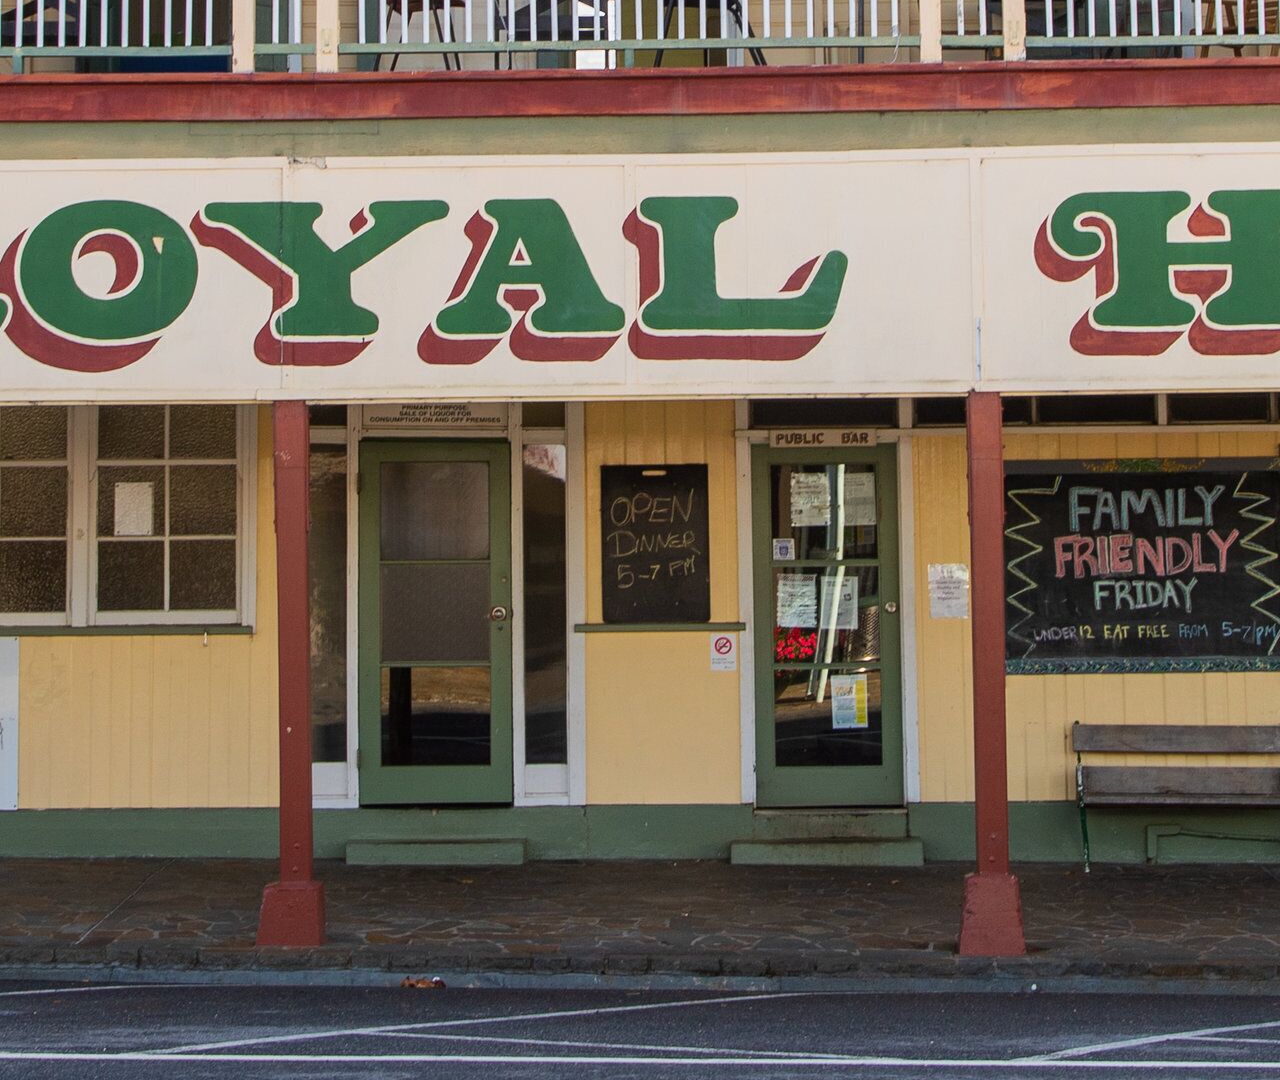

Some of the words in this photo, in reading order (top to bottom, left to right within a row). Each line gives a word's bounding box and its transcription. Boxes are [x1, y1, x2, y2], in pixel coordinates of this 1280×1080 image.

[775, 431, 824, 446] PUBLIC
[841, 431, 869, 445] BAR
[609, 488, 695, 527] OPEN
[1068, 484, 1225, 532] FAMILY
[1053, 528, 1240, 579] FRIENDLY
[617, 564, 661, 589] 5-7
[1093, 577, 1198, 613] FRIDAY
[1033, 626, 1078, 641] UNDER
[1079, 625, 1095, 639] 12
[1103, 624, 1130, 639] EAT
[1137, 624, 1170, 639] FREE
[1178, 623, 1209, 638] FROM
